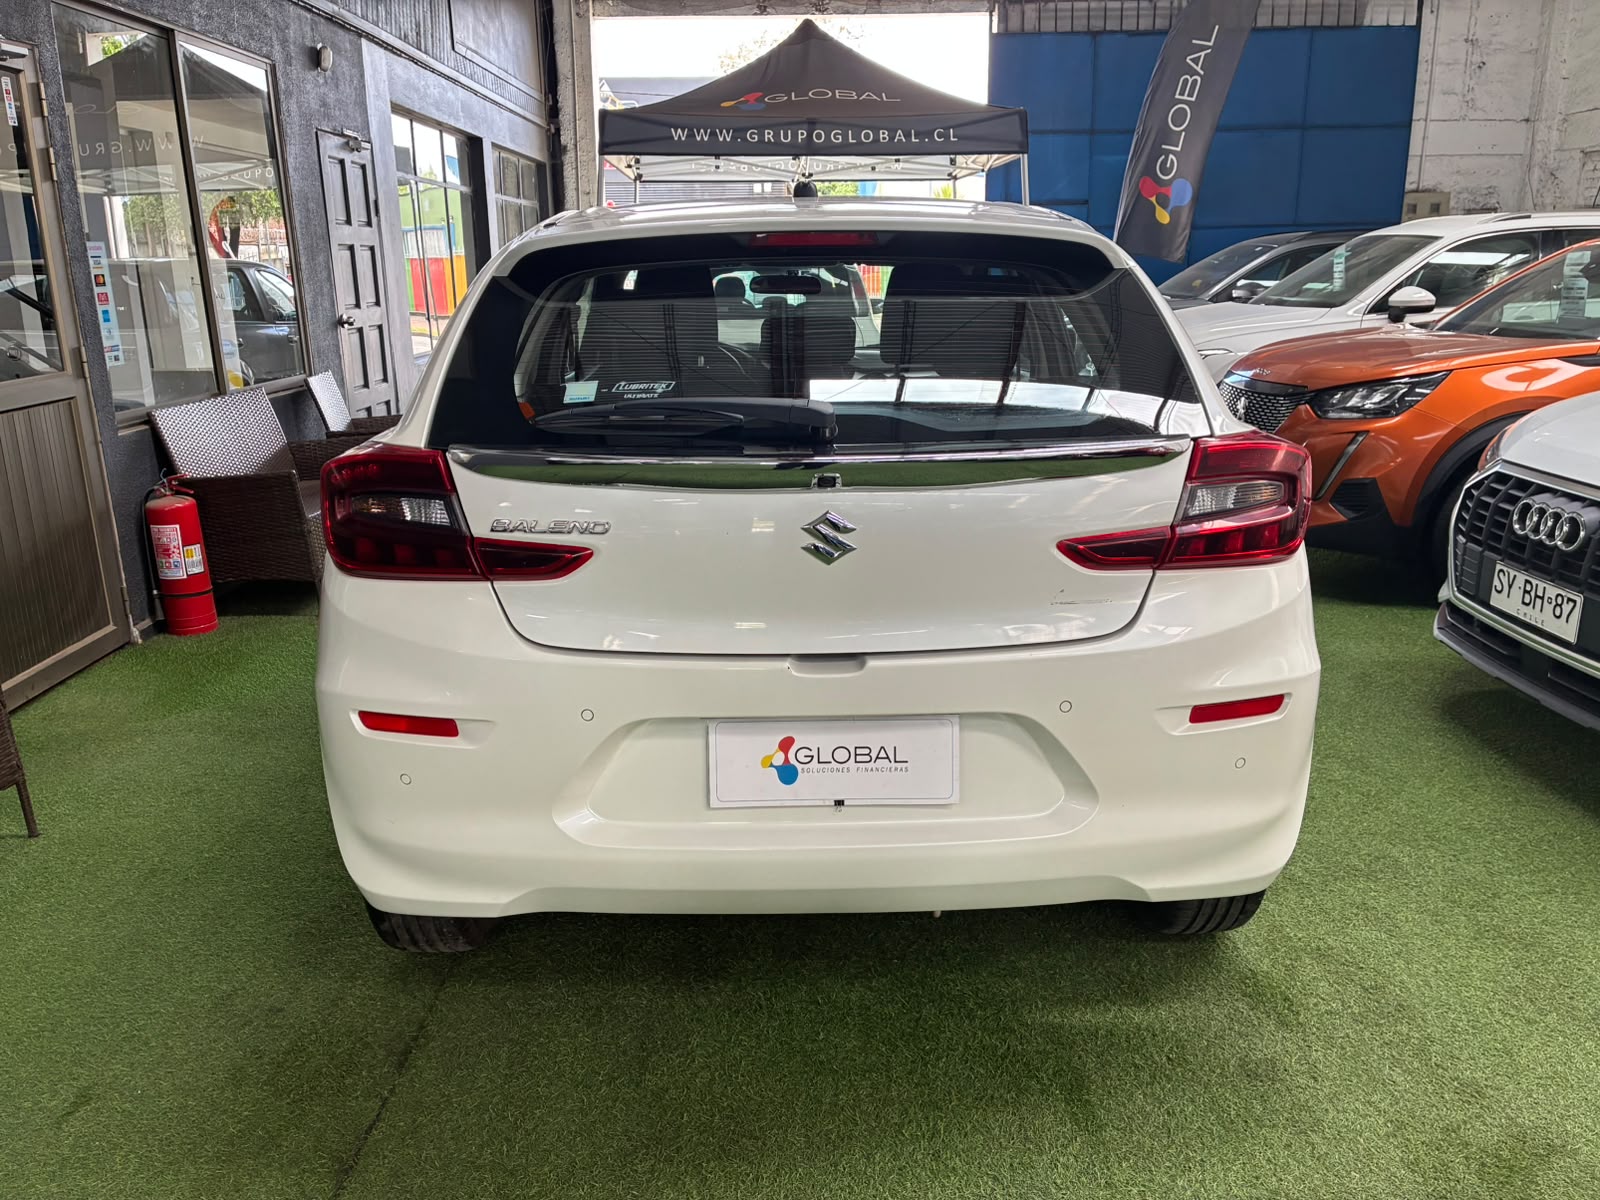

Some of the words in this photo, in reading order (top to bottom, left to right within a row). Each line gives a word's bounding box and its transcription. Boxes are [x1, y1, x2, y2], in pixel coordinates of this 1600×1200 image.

[764, 88, 901, 103] GLOBAL
[1156, 24, 1219, 180] GLOBAL
[670, 127, 958, 143] WWW.GRUPOGLOBAL.CL
[490, 519, 611, 535] BALENO
[794, 745, 909, 765] GLOBAL
[800, 766, 851, 774] SOLUCIONES
[856, 766, 909, 774] FINANCIERAS
